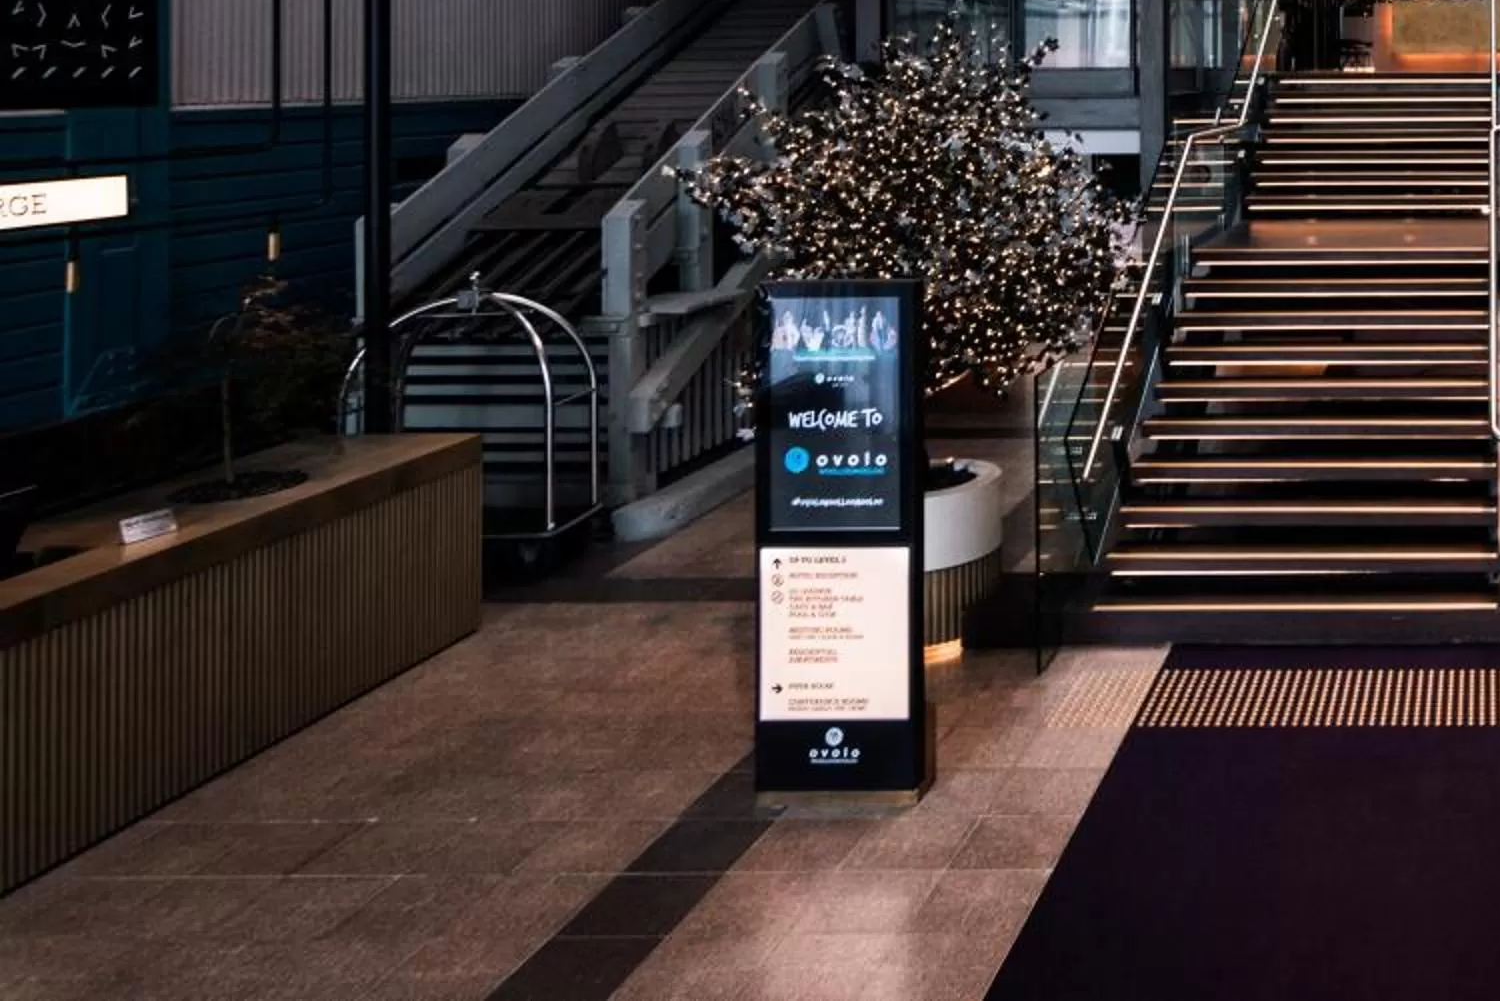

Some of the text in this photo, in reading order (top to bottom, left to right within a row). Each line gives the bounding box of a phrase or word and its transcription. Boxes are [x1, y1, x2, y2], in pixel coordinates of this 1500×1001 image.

[788, 407, 884, 431] WELCOME TO
[816, 450, 888, 467] ovolo
[809, 746, 861, 758] ovolo
